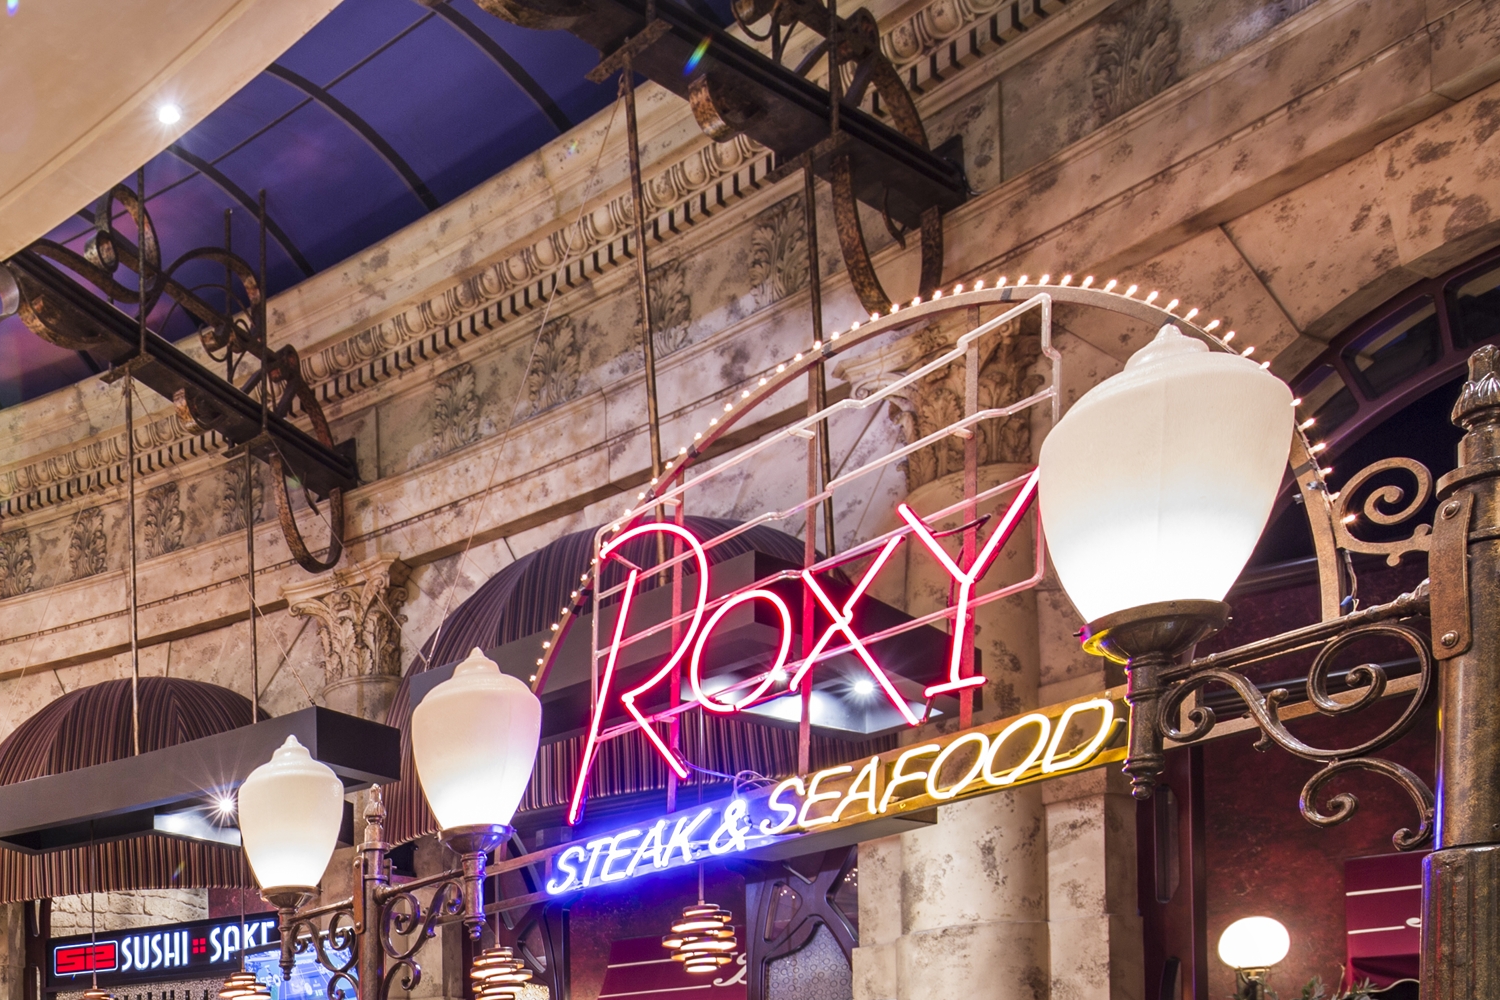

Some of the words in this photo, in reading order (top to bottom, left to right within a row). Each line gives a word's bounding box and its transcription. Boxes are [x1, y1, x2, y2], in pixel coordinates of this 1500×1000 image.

[545, 806, 713, 896] STEAK
[707, 798, 752, 857] &
[759, 697, 1115, 829] SEAFOOD
[120, 930, 189, 973] SUSHI
